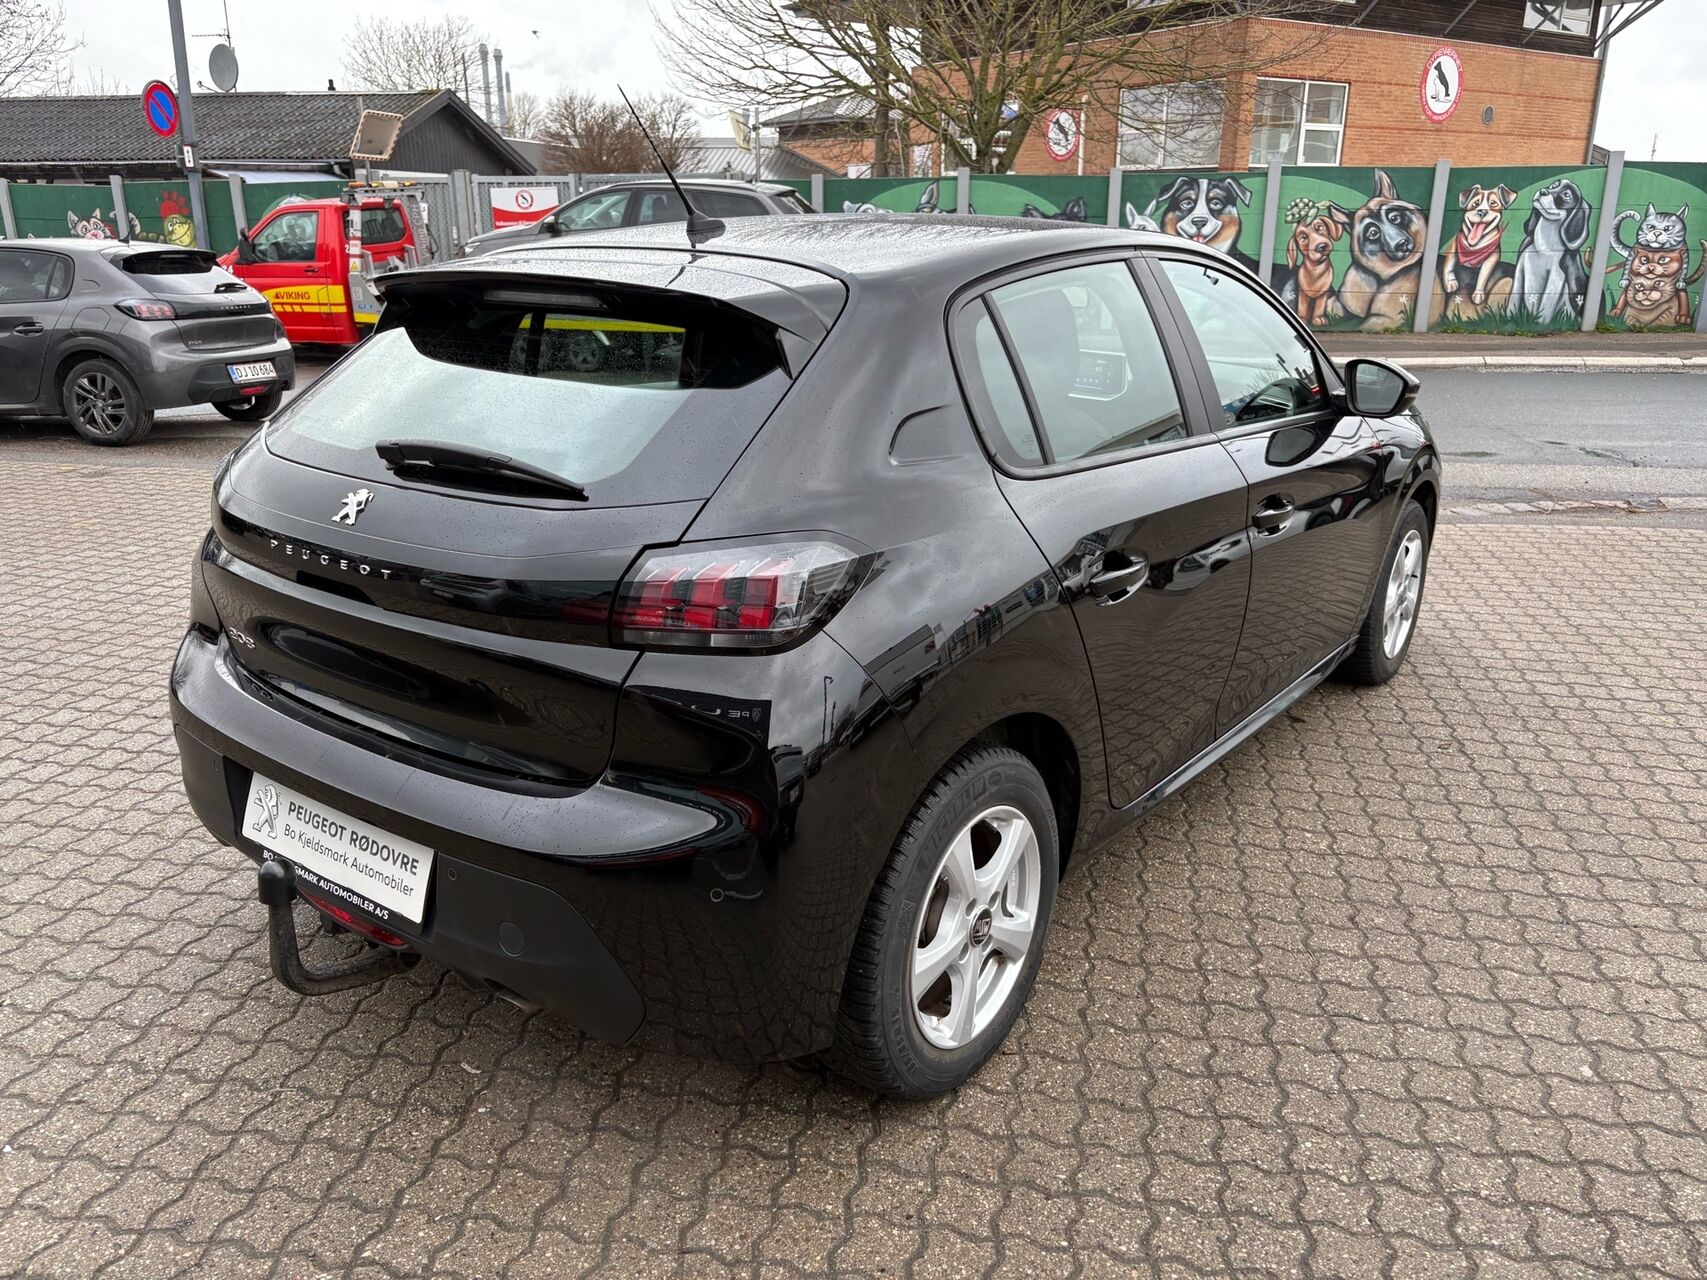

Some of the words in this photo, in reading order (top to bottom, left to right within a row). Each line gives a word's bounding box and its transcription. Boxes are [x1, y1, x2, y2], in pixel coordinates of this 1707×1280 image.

[279, 292, 311, 300] VIKING
[270, 539, 392, 580] PEUGEOT
[229, 627, 256, 650] 208
[284, 823, 296, 840] Bo
[298, 830, 349, 867] Kjeldsmark
[351, 857, 415, 897] Automobiler
[288, 801, 347, 841] PEUGEOT
[350, 830, 420, 876] RØDOVRE
[263, 850, 273, 861] BO
[319, 879, 375, 914] AUTOMOBILER
[375, 906, 389, 920] A/S
